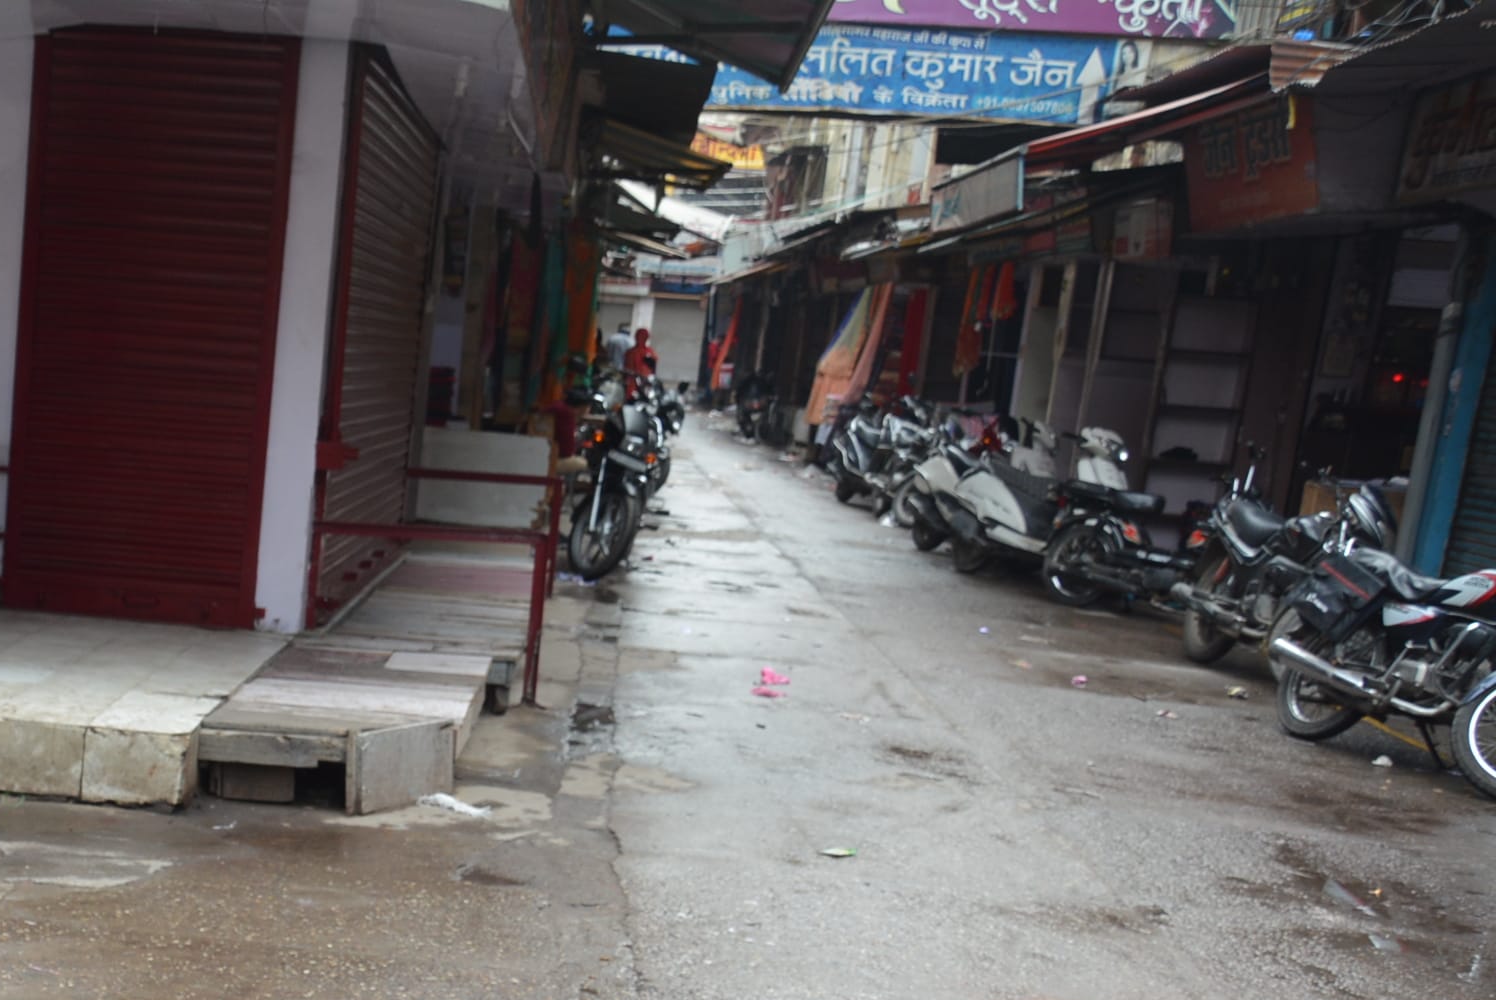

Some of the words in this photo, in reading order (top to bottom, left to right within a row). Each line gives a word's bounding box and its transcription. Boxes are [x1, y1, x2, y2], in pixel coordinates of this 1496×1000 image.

[800, 37, 896, 76] ललित
[904, 49, 1003, 91] कुमार
[1009, 54, 1077, 89] जैन
[873, 84, 894, 104] के
[901, 85, 968, 109] विक्रेता
